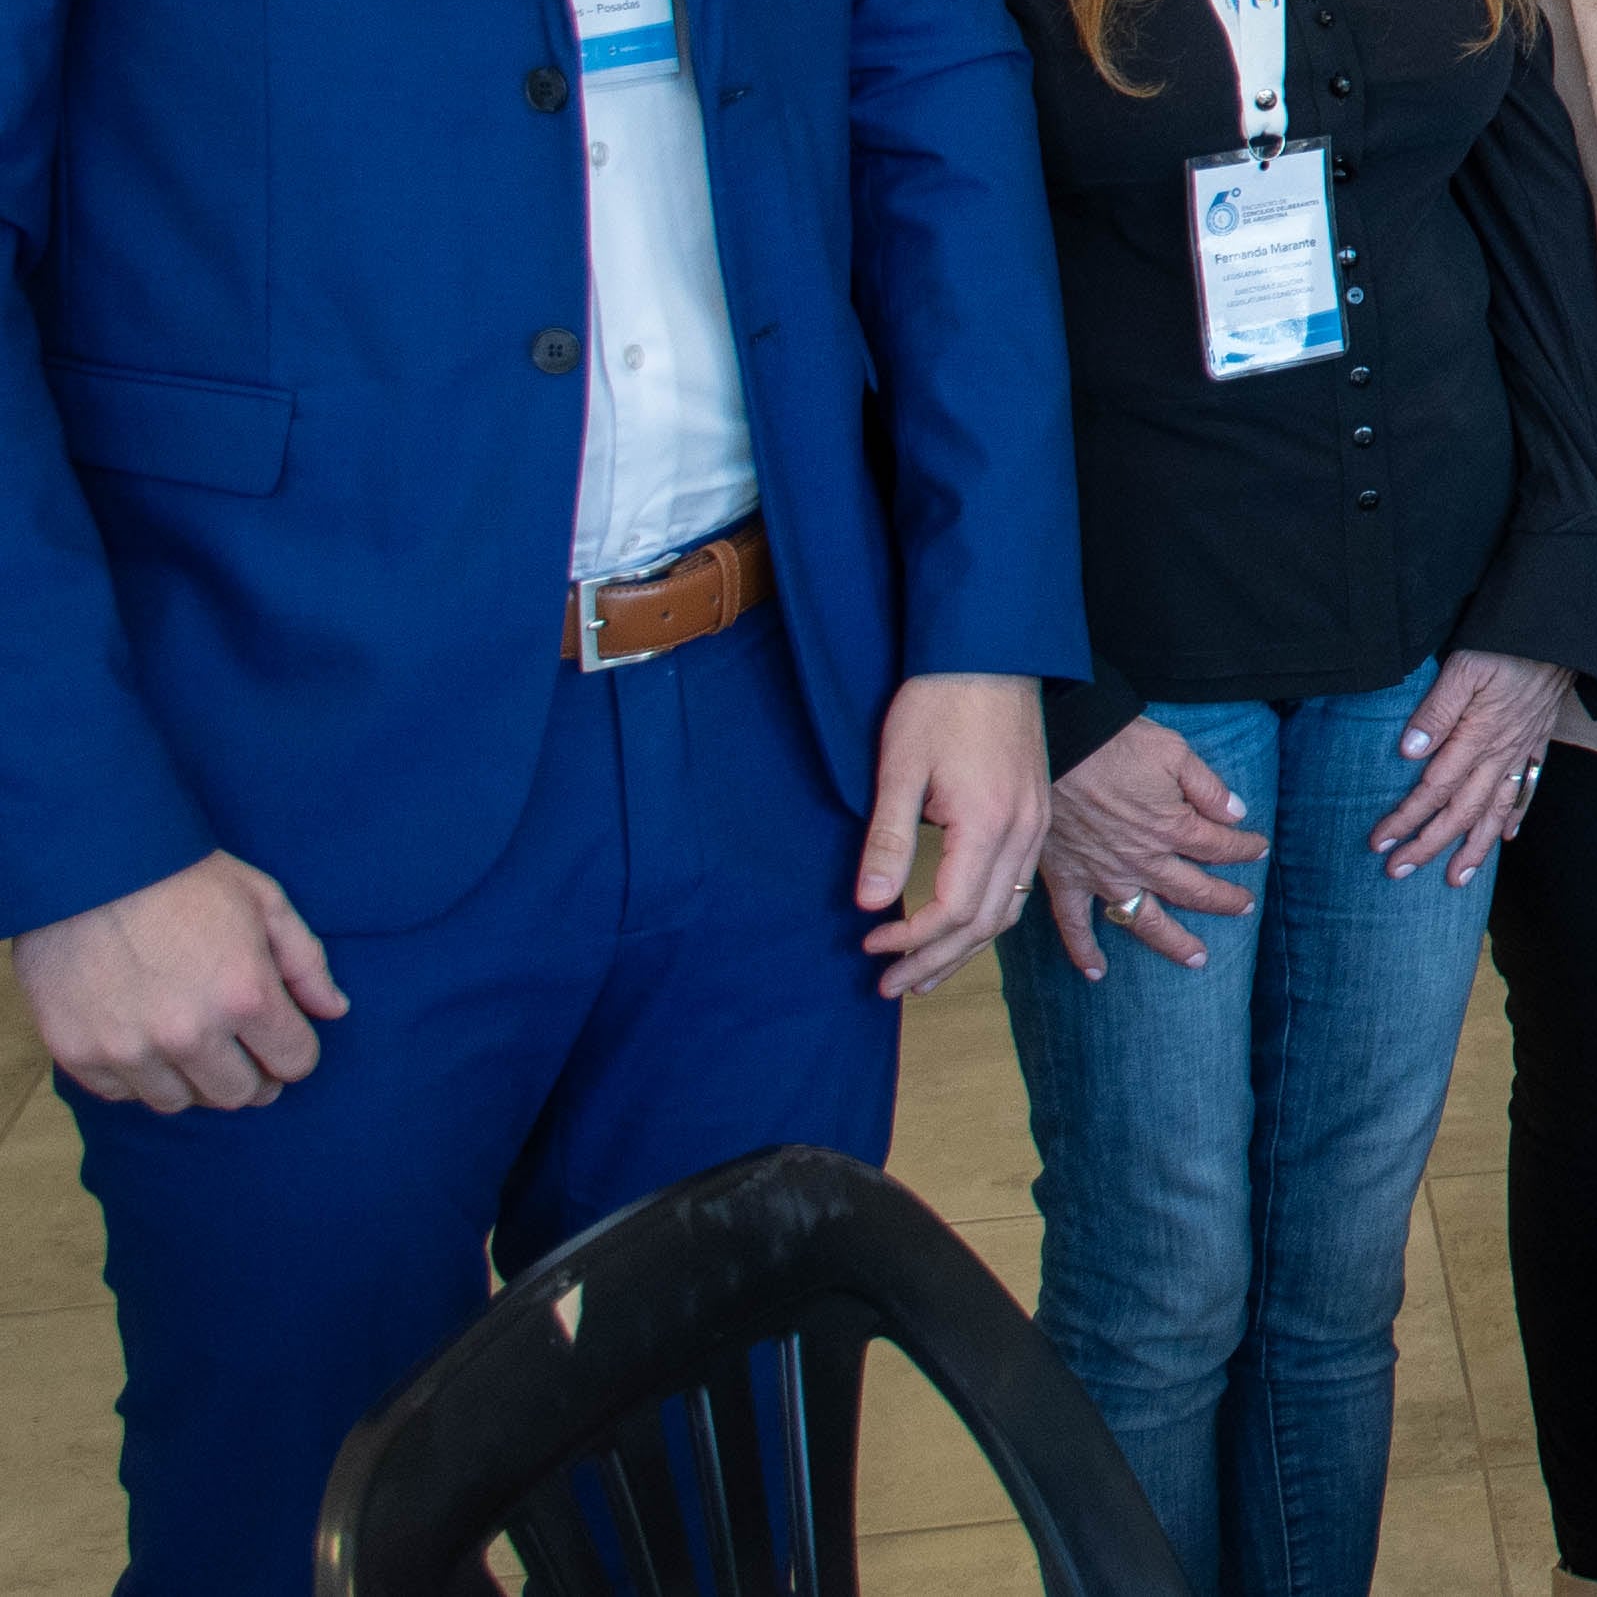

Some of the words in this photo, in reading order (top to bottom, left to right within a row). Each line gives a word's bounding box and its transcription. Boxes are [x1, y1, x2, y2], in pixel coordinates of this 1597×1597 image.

[597, 0, 640, 14] Posadas
[1215, 246, 1268, 265] Fernanda
[1270, 238, 1317, 255] Marante
